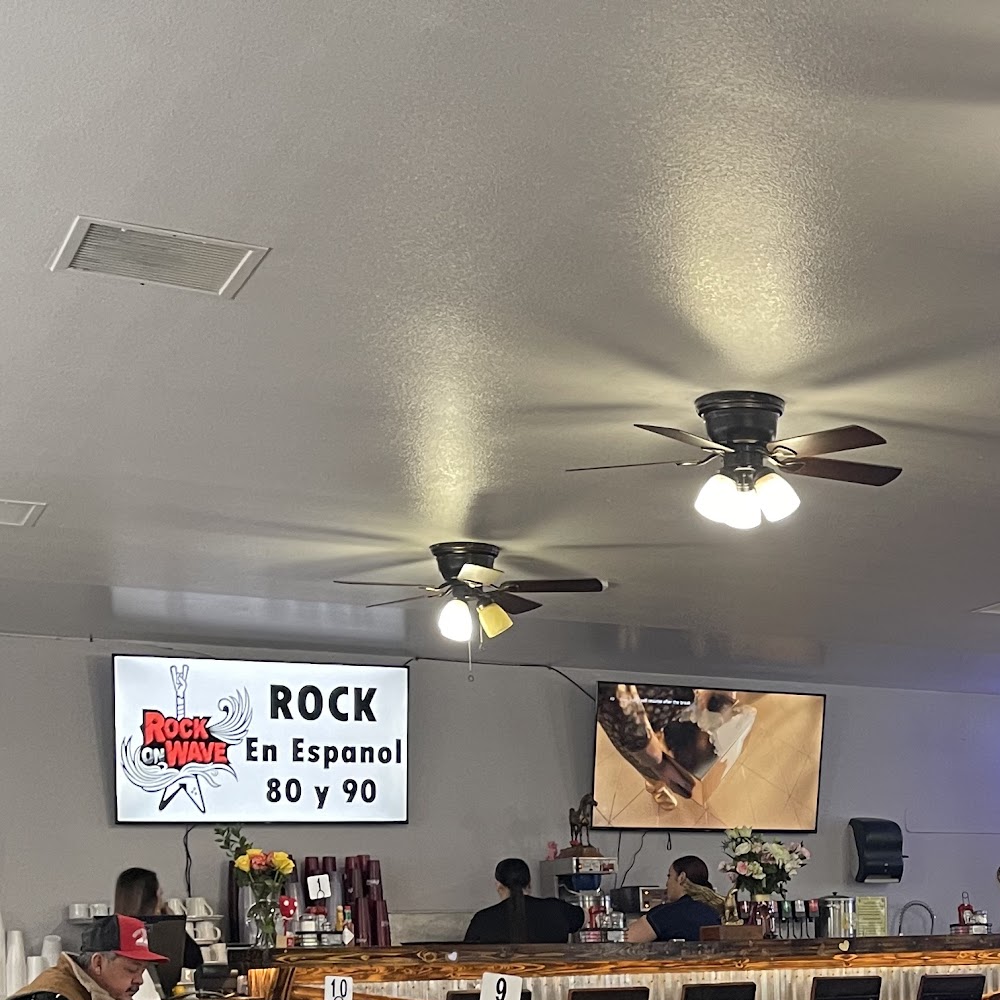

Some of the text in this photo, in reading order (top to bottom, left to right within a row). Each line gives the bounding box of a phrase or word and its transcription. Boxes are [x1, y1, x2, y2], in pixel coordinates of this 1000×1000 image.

[270, 684, 377, 722] ROCK
[144, 711, 209, 745] ROCK
[165, 740, 227, 767] WAVE
[246, 737, 401, 769] En Espanol
[266, 778, 376, 809] 80 y 90
[331, 978, 348, 998] 10
